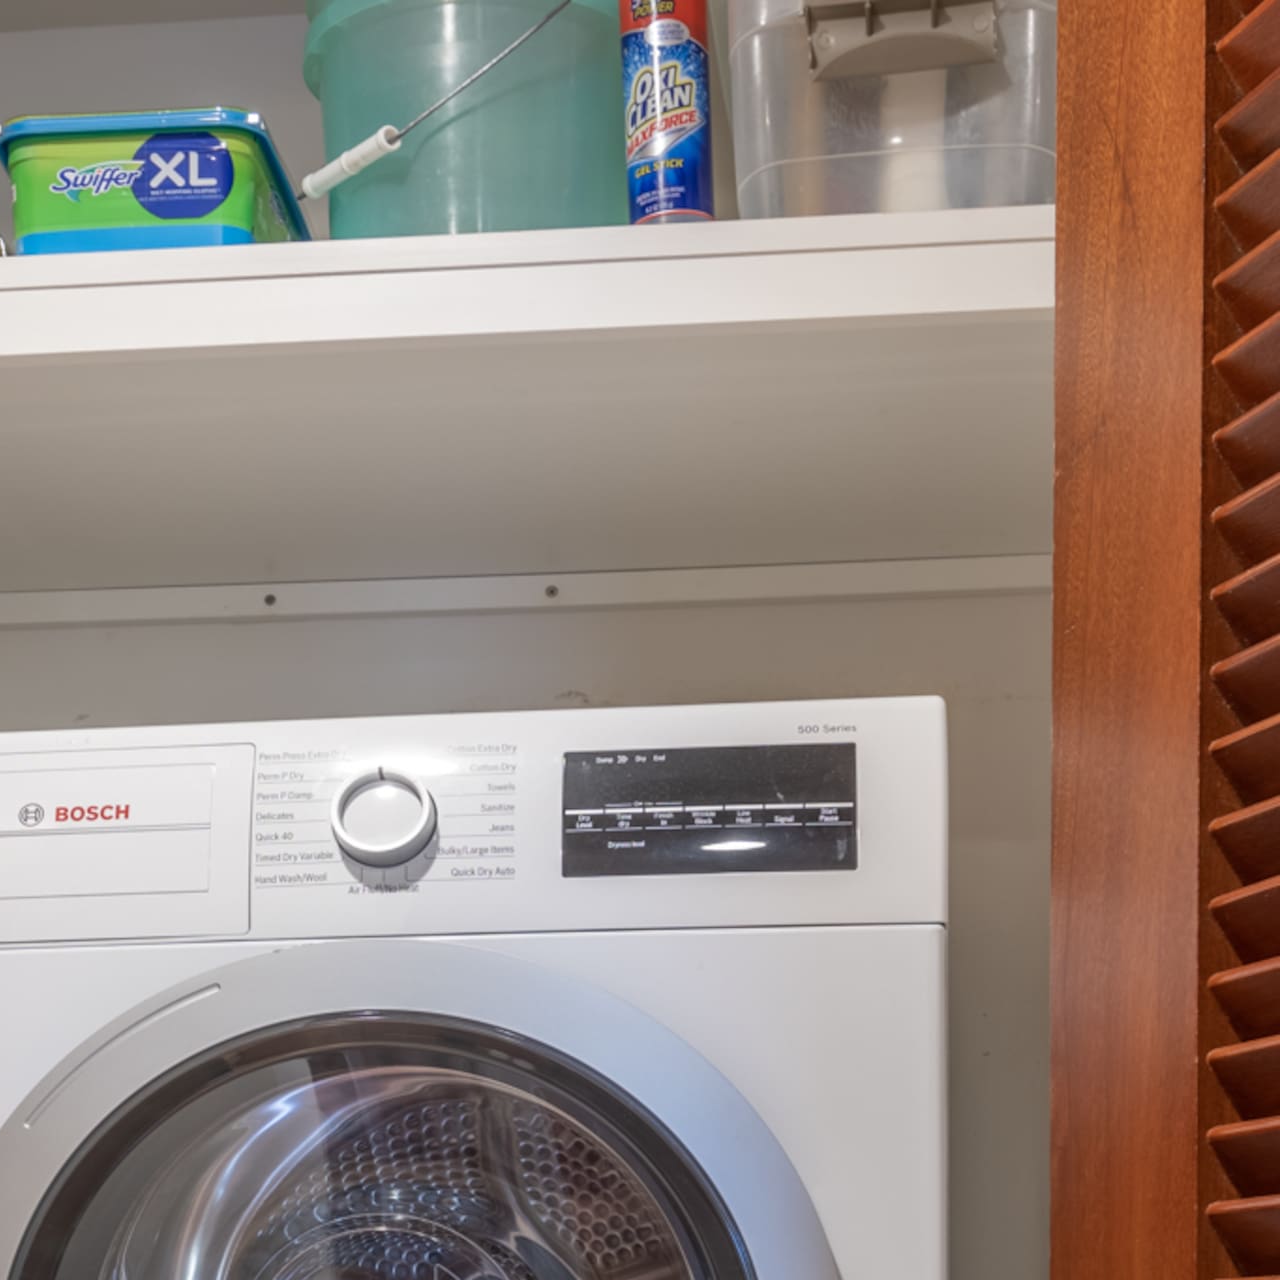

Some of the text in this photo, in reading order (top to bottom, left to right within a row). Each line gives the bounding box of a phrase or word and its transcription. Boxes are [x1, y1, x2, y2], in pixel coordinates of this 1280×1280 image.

[50, 151, 218, 195] Swiffer XL
[797, 723, 857, 734] 500 Series
[501, 763, 517, 773] Dry
[55, 804, 130, 822] BOSCH
[256, 812, 294, 821] Delicates
[489, 824, 515, 833] Jeans
[255, 833, 279, 842] Quick
[282, 852, 298, 862] Dry
[300, 851, 334, 860] Variable
[451, 866, 516, 878] Quick Dry Auto
